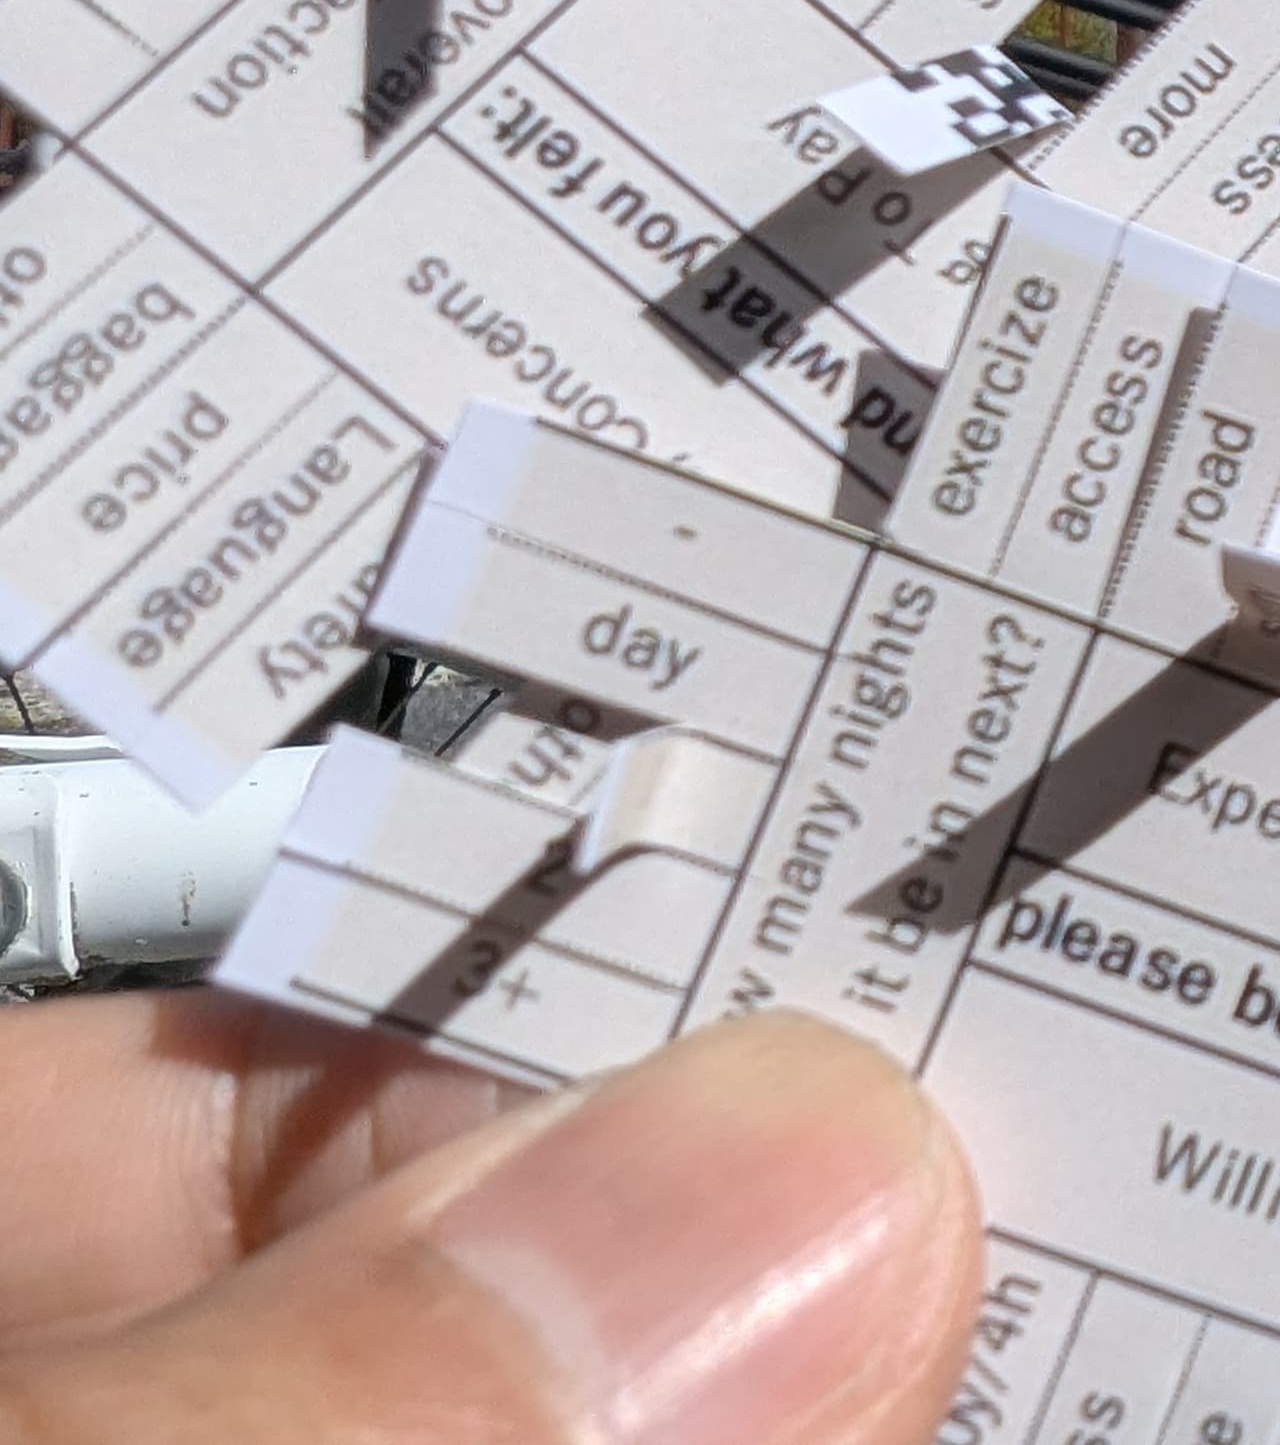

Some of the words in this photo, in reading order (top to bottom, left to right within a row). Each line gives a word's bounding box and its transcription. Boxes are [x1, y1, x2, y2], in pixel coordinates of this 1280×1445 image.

[481, 85, 605, 198] felt:
[1119, 43, 1237, 158] more
[597, 181, 724, 281] you
[701, 266, 850, 396] what
[931, 274, 1059, 517] exercize
[1049, 334, 1163, 544] access
[80, 390, 228, 533] price
[1175, 411, 1256, 546] road
[116, 415, 398, 668] Language
[581, 604, 700, 689] day
[950, 614, 1047, 784] next?
[755, 781, 862, 956] many
[829, 579, 936, 770] nights
[903, 801, 974, 868] in
[865, 875, 944, 953] be
[999, 895, 1216, 1004] please
[840, 966, 910, 1014] it
